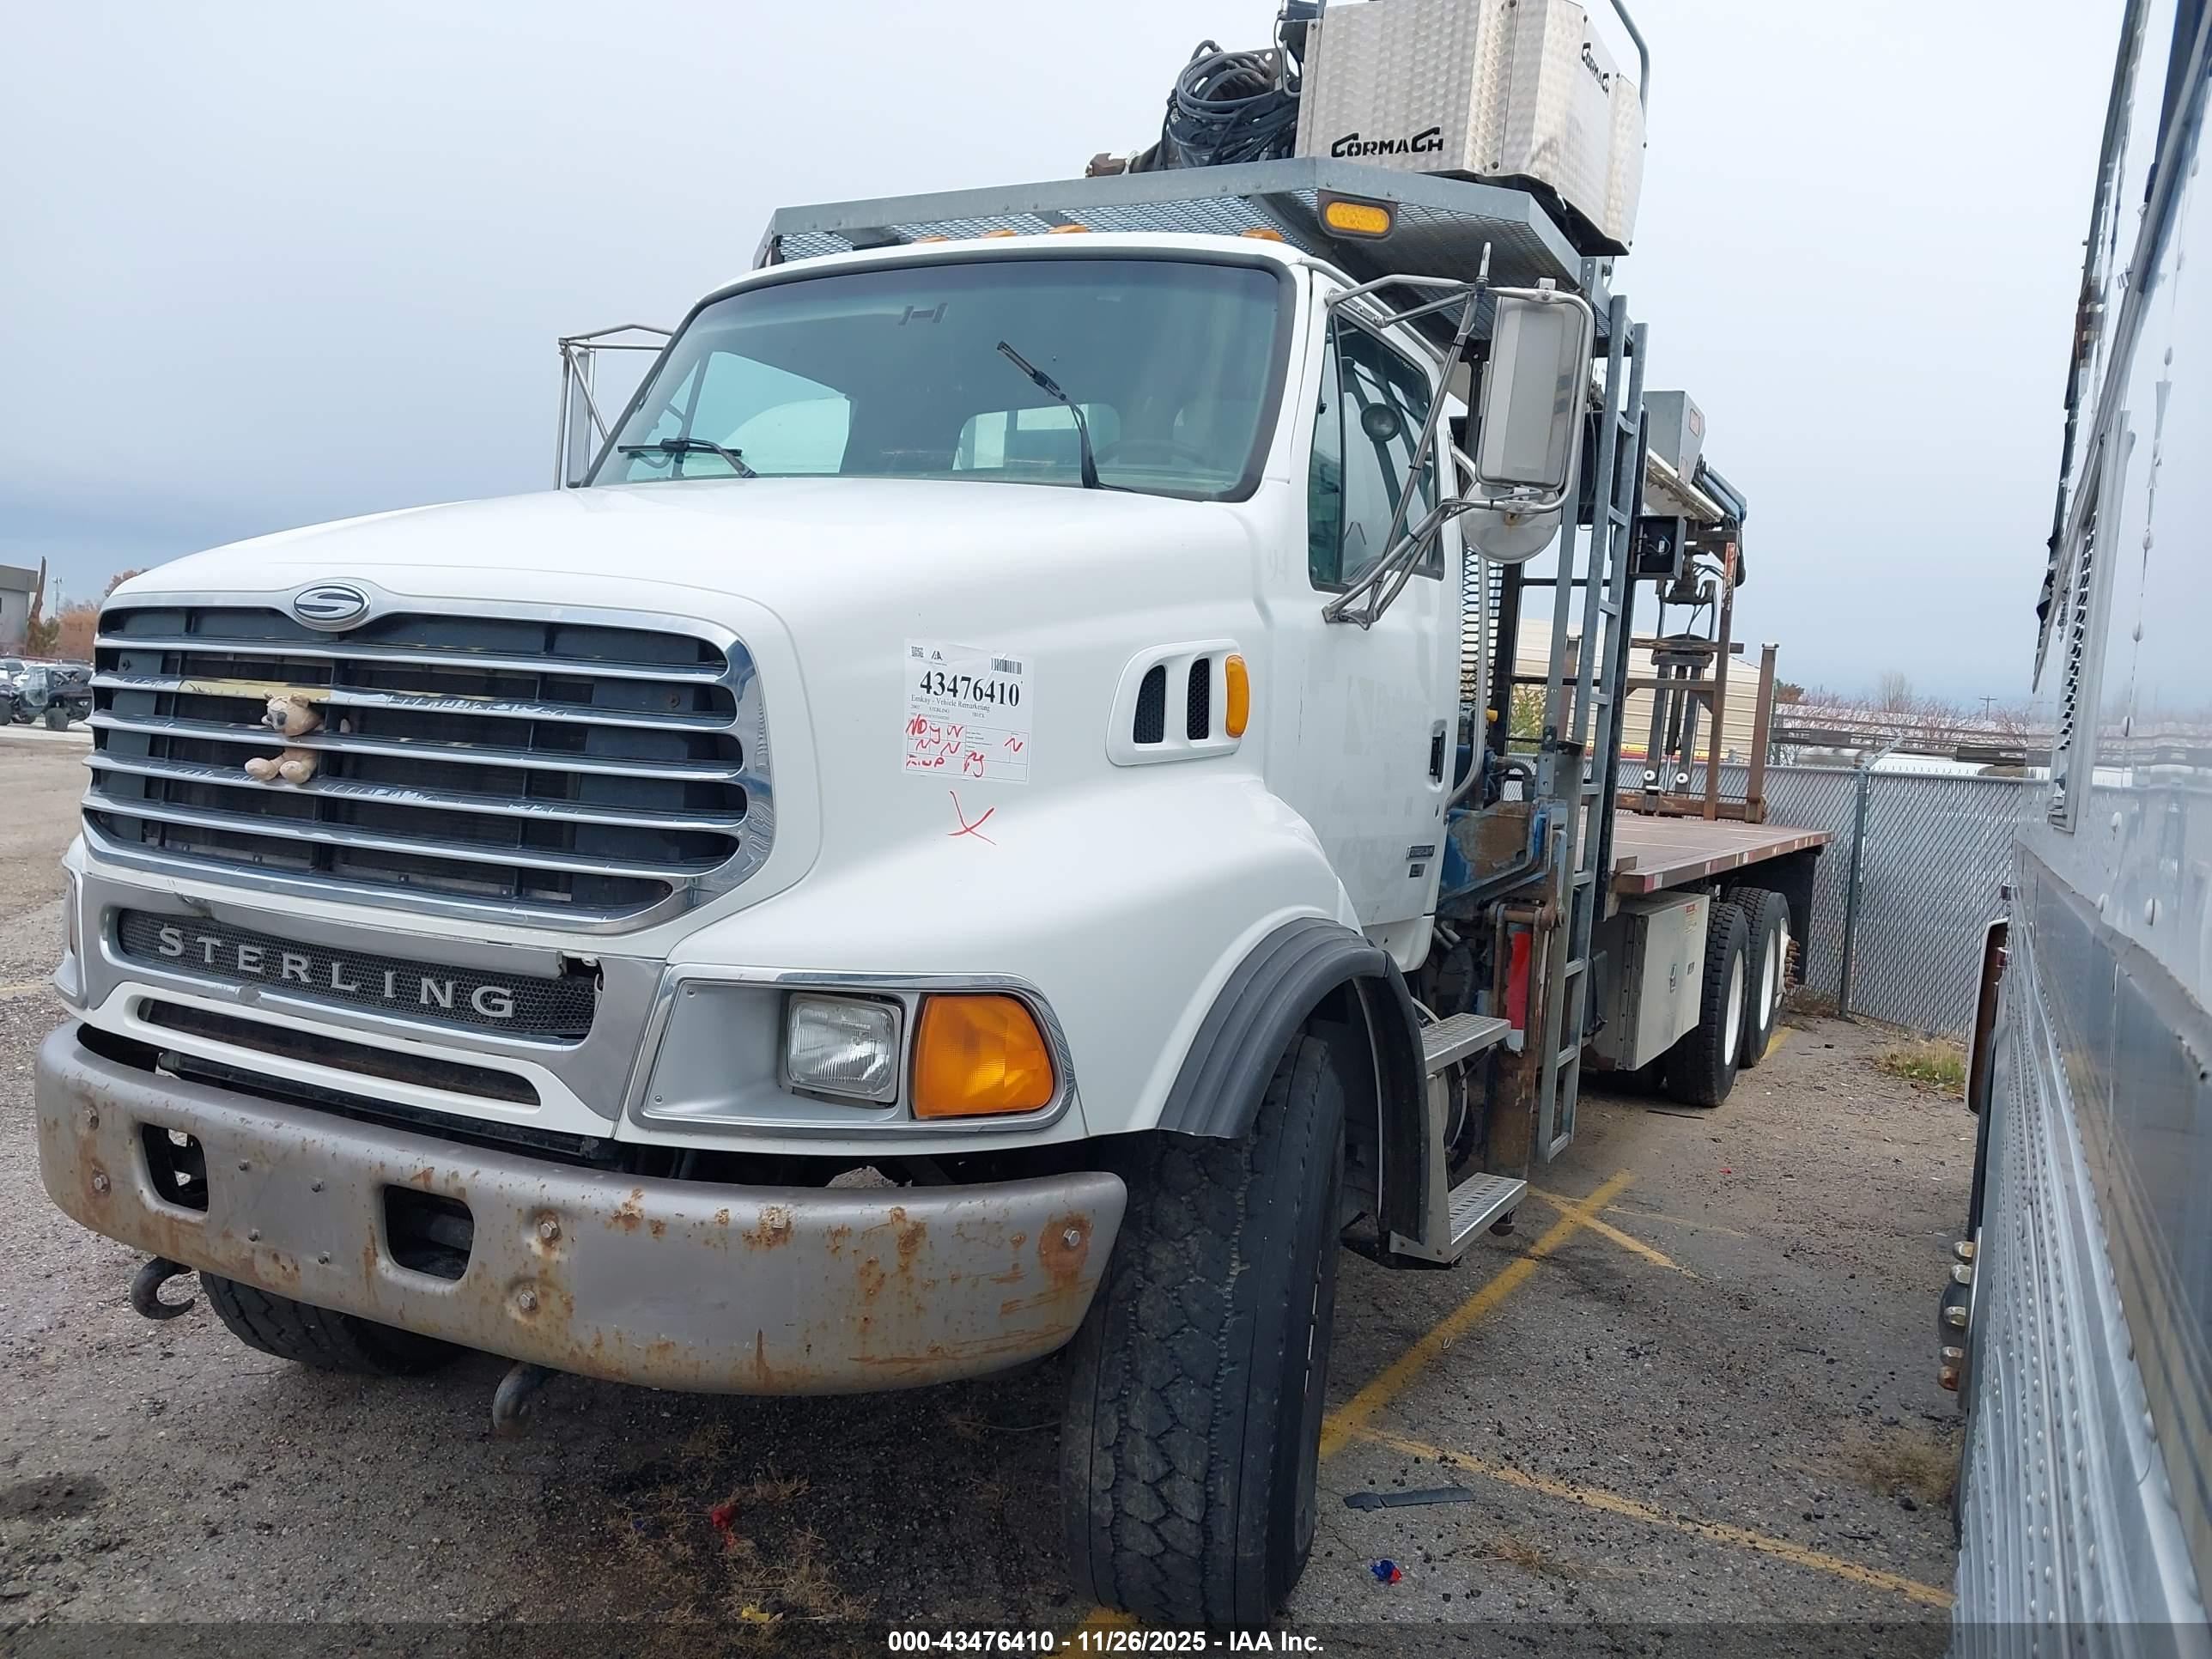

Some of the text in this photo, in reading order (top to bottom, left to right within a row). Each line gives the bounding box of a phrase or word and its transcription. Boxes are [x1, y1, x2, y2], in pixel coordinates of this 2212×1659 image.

[1582, 42, 1609, 100] CORMACH
[1331, 126, 1443, 158] CORMACH
[920, 670, 1020, 707] 43476410
[936, 697, 956, 707] Vehicle
[957, 700, 991, 713] Remarketing
[157, 923, 514, 1018] STERLING
